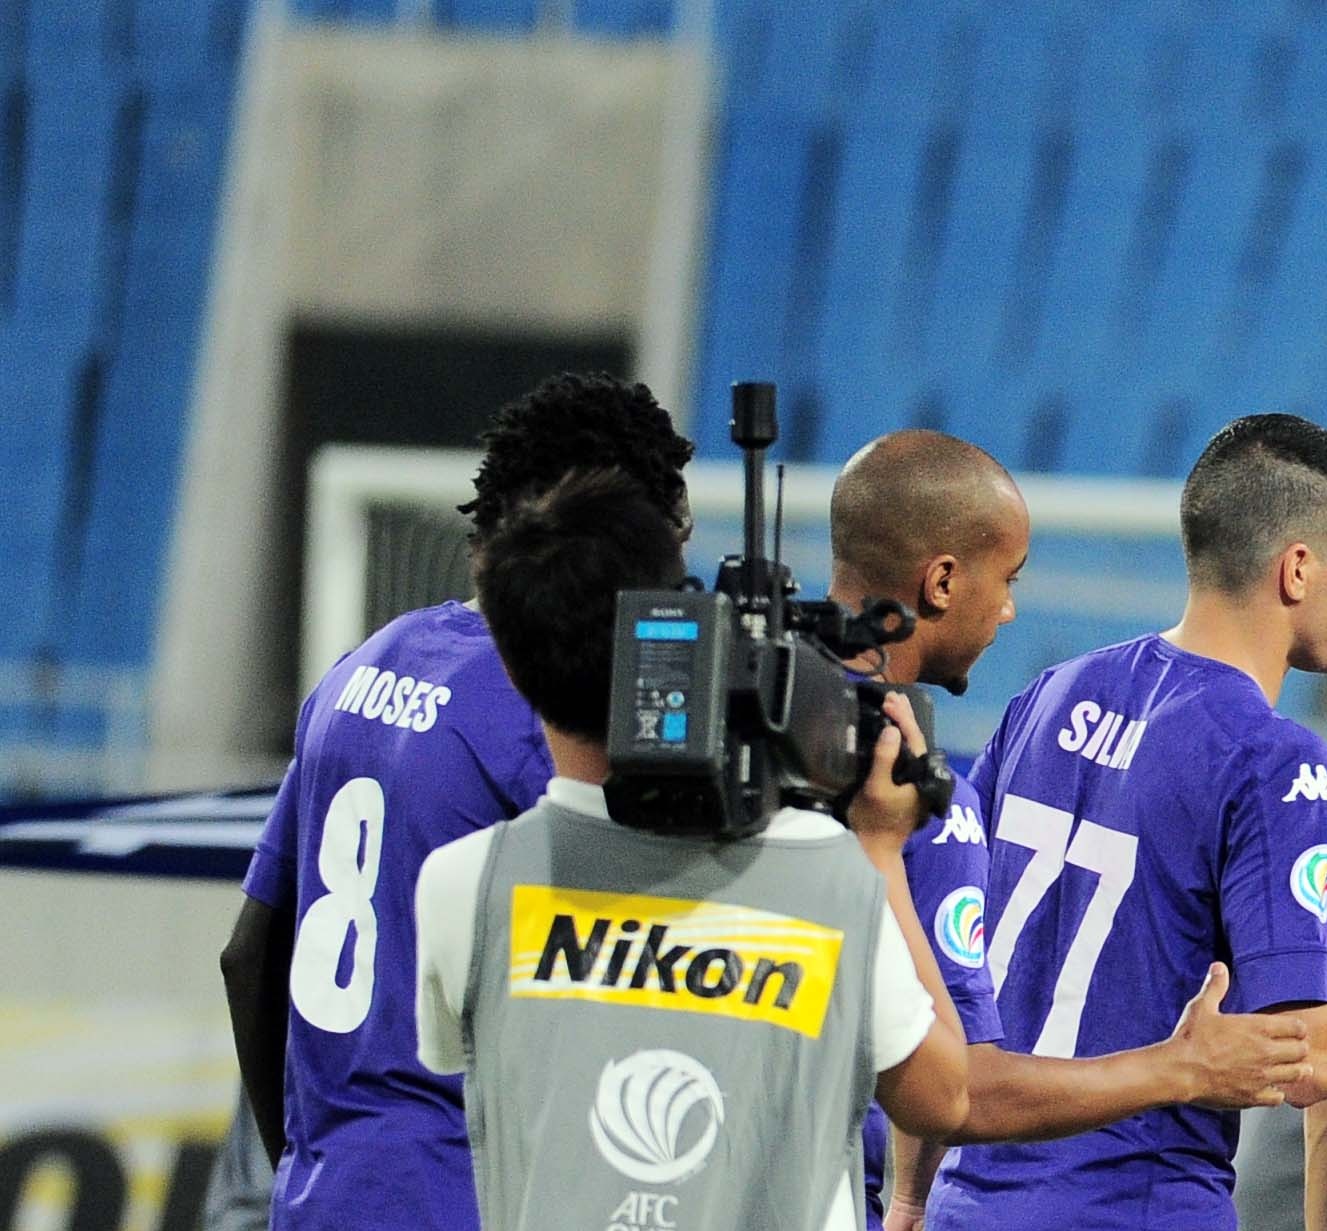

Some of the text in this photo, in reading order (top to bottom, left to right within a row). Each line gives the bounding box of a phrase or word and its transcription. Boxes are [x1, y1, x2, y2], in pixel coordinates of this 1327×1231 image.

[334, 664, 452, 733] MOSES
[290, 777, 385, 1034] 8
[989, 794, 1139, 1060] 77
[534, 914, 805, 1010] Nikon
[610, 1191, 679, 1228] AFC
